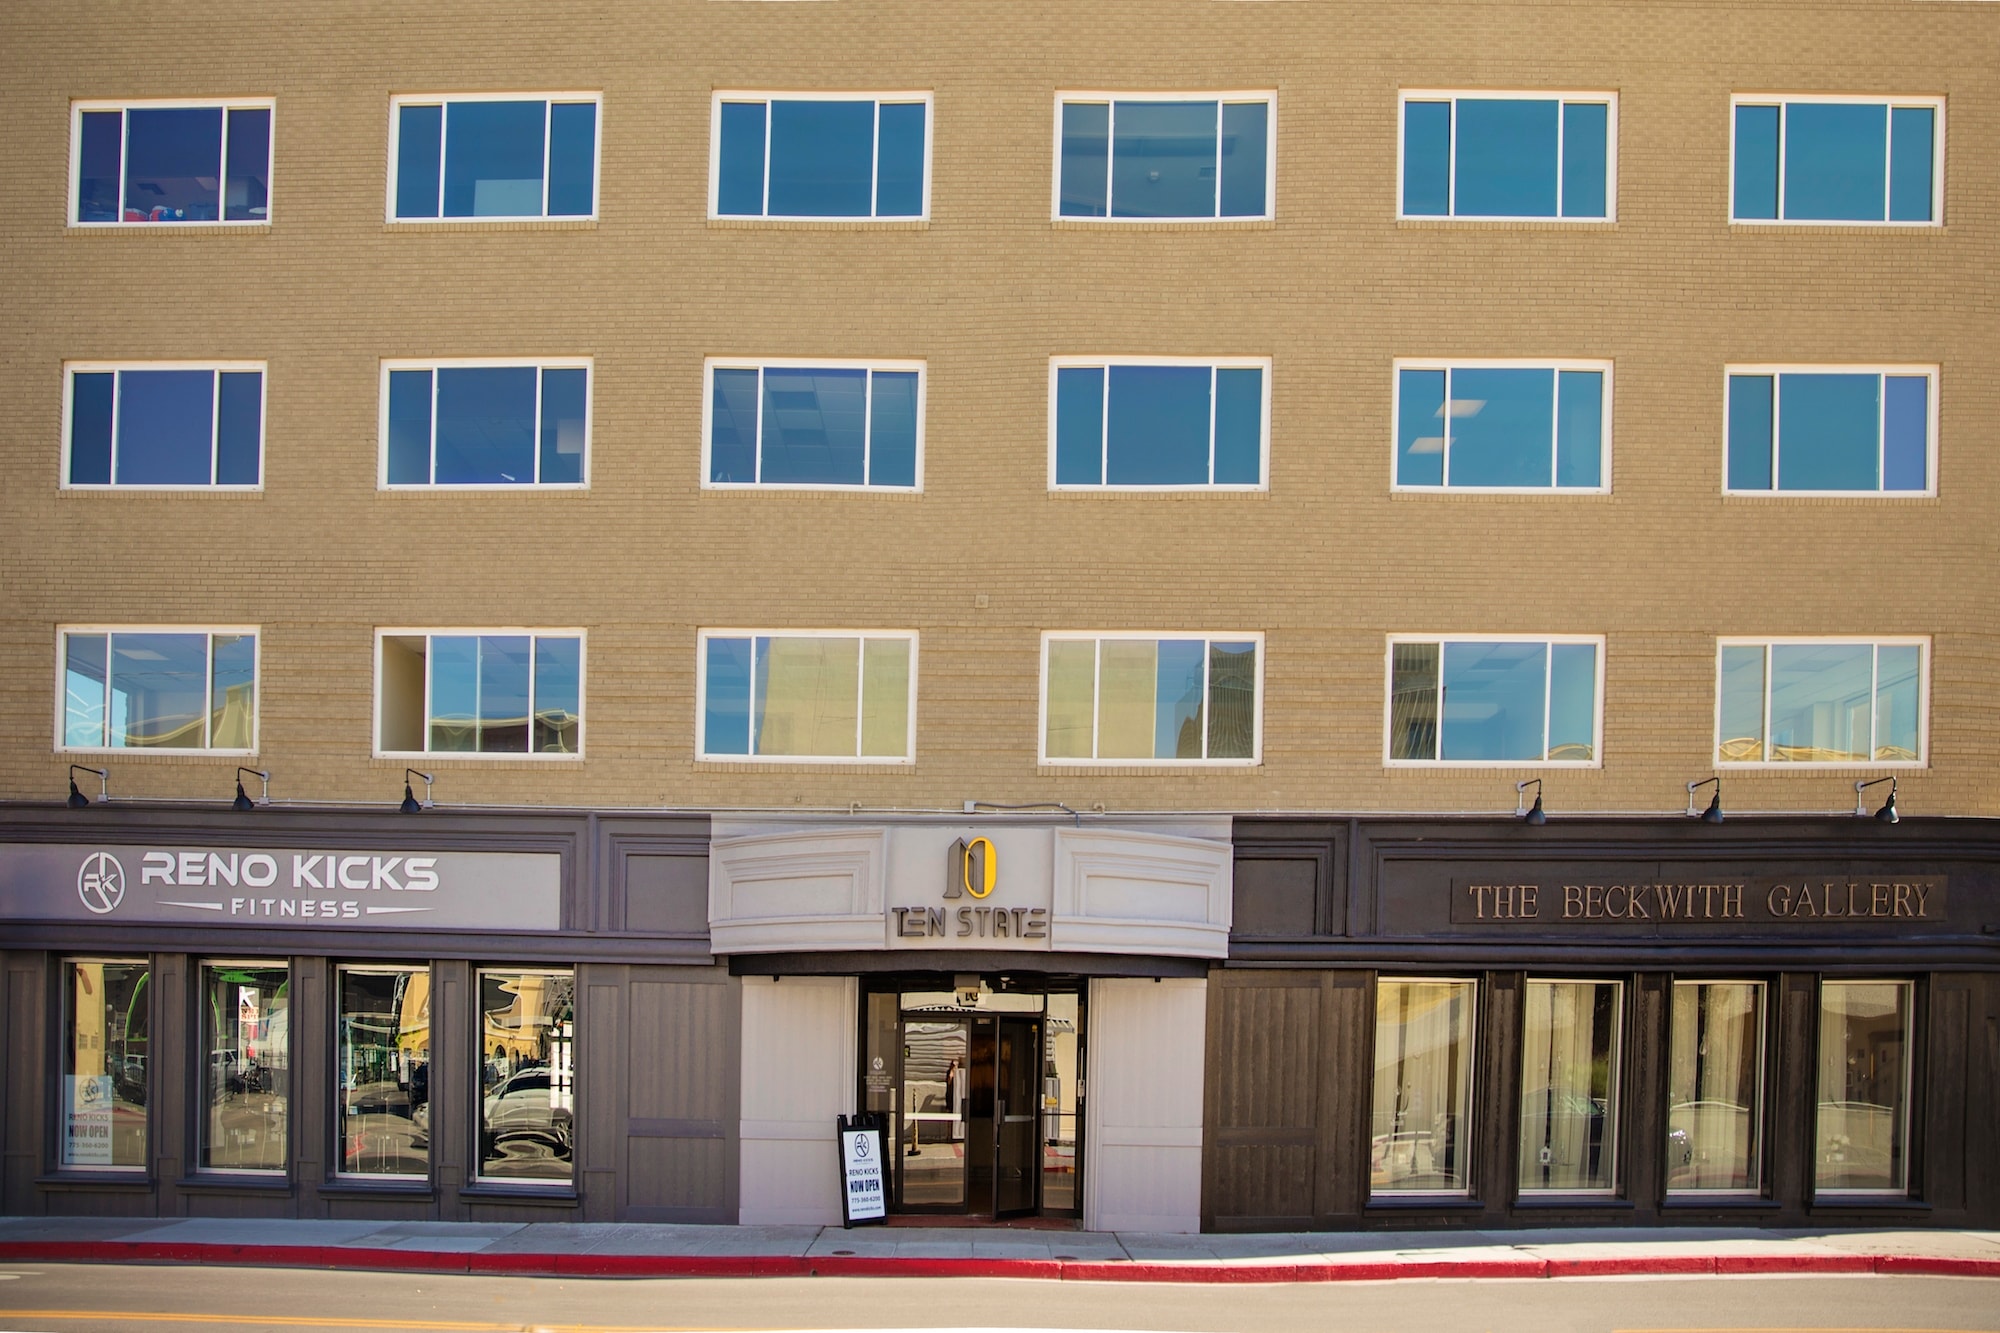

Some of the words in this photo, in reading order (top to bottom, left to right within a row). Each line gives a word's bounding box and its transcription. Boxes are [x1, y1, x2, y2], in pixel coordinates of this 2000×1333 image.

[141, 852, 278, 887] RENO
[292, 854, 440, 891] KICKS
[942, 836, 997, 899] 10
[231, 897, 361, 918] FITNESS
[1469, 885, 1540, 918] THE
[1562, 883, 1745, 918] BECKWITH
[1767, 882, 1934, 917] GALLERY
[891, 906, 946, 937] TEN
[956, 906, 1047, 938] STATE
[68, 1113, 88, 1121] RENO
[89, 1113, 109, 1122] KICKS
[68, 1124, 88, 1138] NOW
[89, 1124, 109, 1138] OPEN
[849, 1168, 864, 1177] RENO
[864, 1167, 879, 1176] KICKS
[850, 1180, 864, 1194] NOW
[865, 1179, 880, 1192] OPEN
